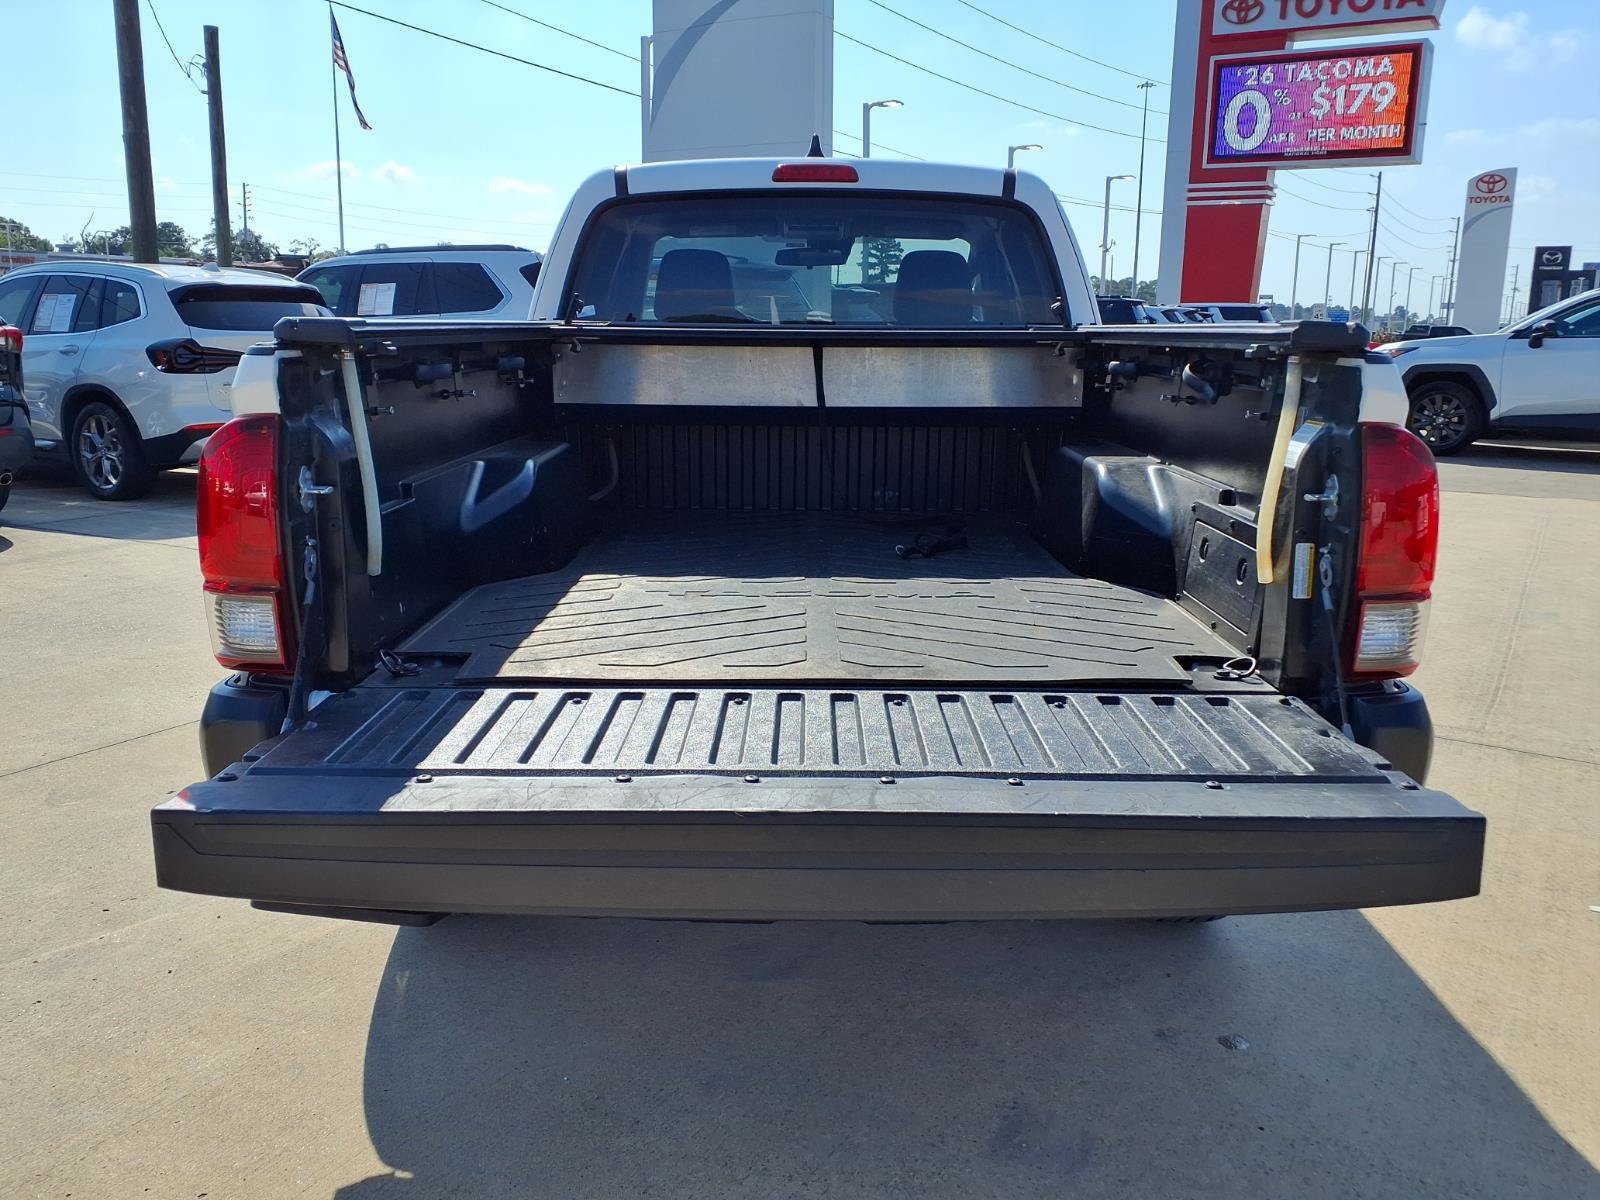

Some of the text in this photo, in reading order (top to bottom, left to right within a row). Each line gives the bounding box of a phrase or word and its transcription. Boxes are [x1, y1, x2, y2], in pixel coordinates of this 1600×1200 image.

[1285, 58, 1393, 82] TACOMA
[1310, 80, 1397, 120] $179
[1268, 133, 1296, 144] APR
[1306, 124, 1401, 141] PER MONTH
[1468, 195, 1511, 204] TOYOTA
